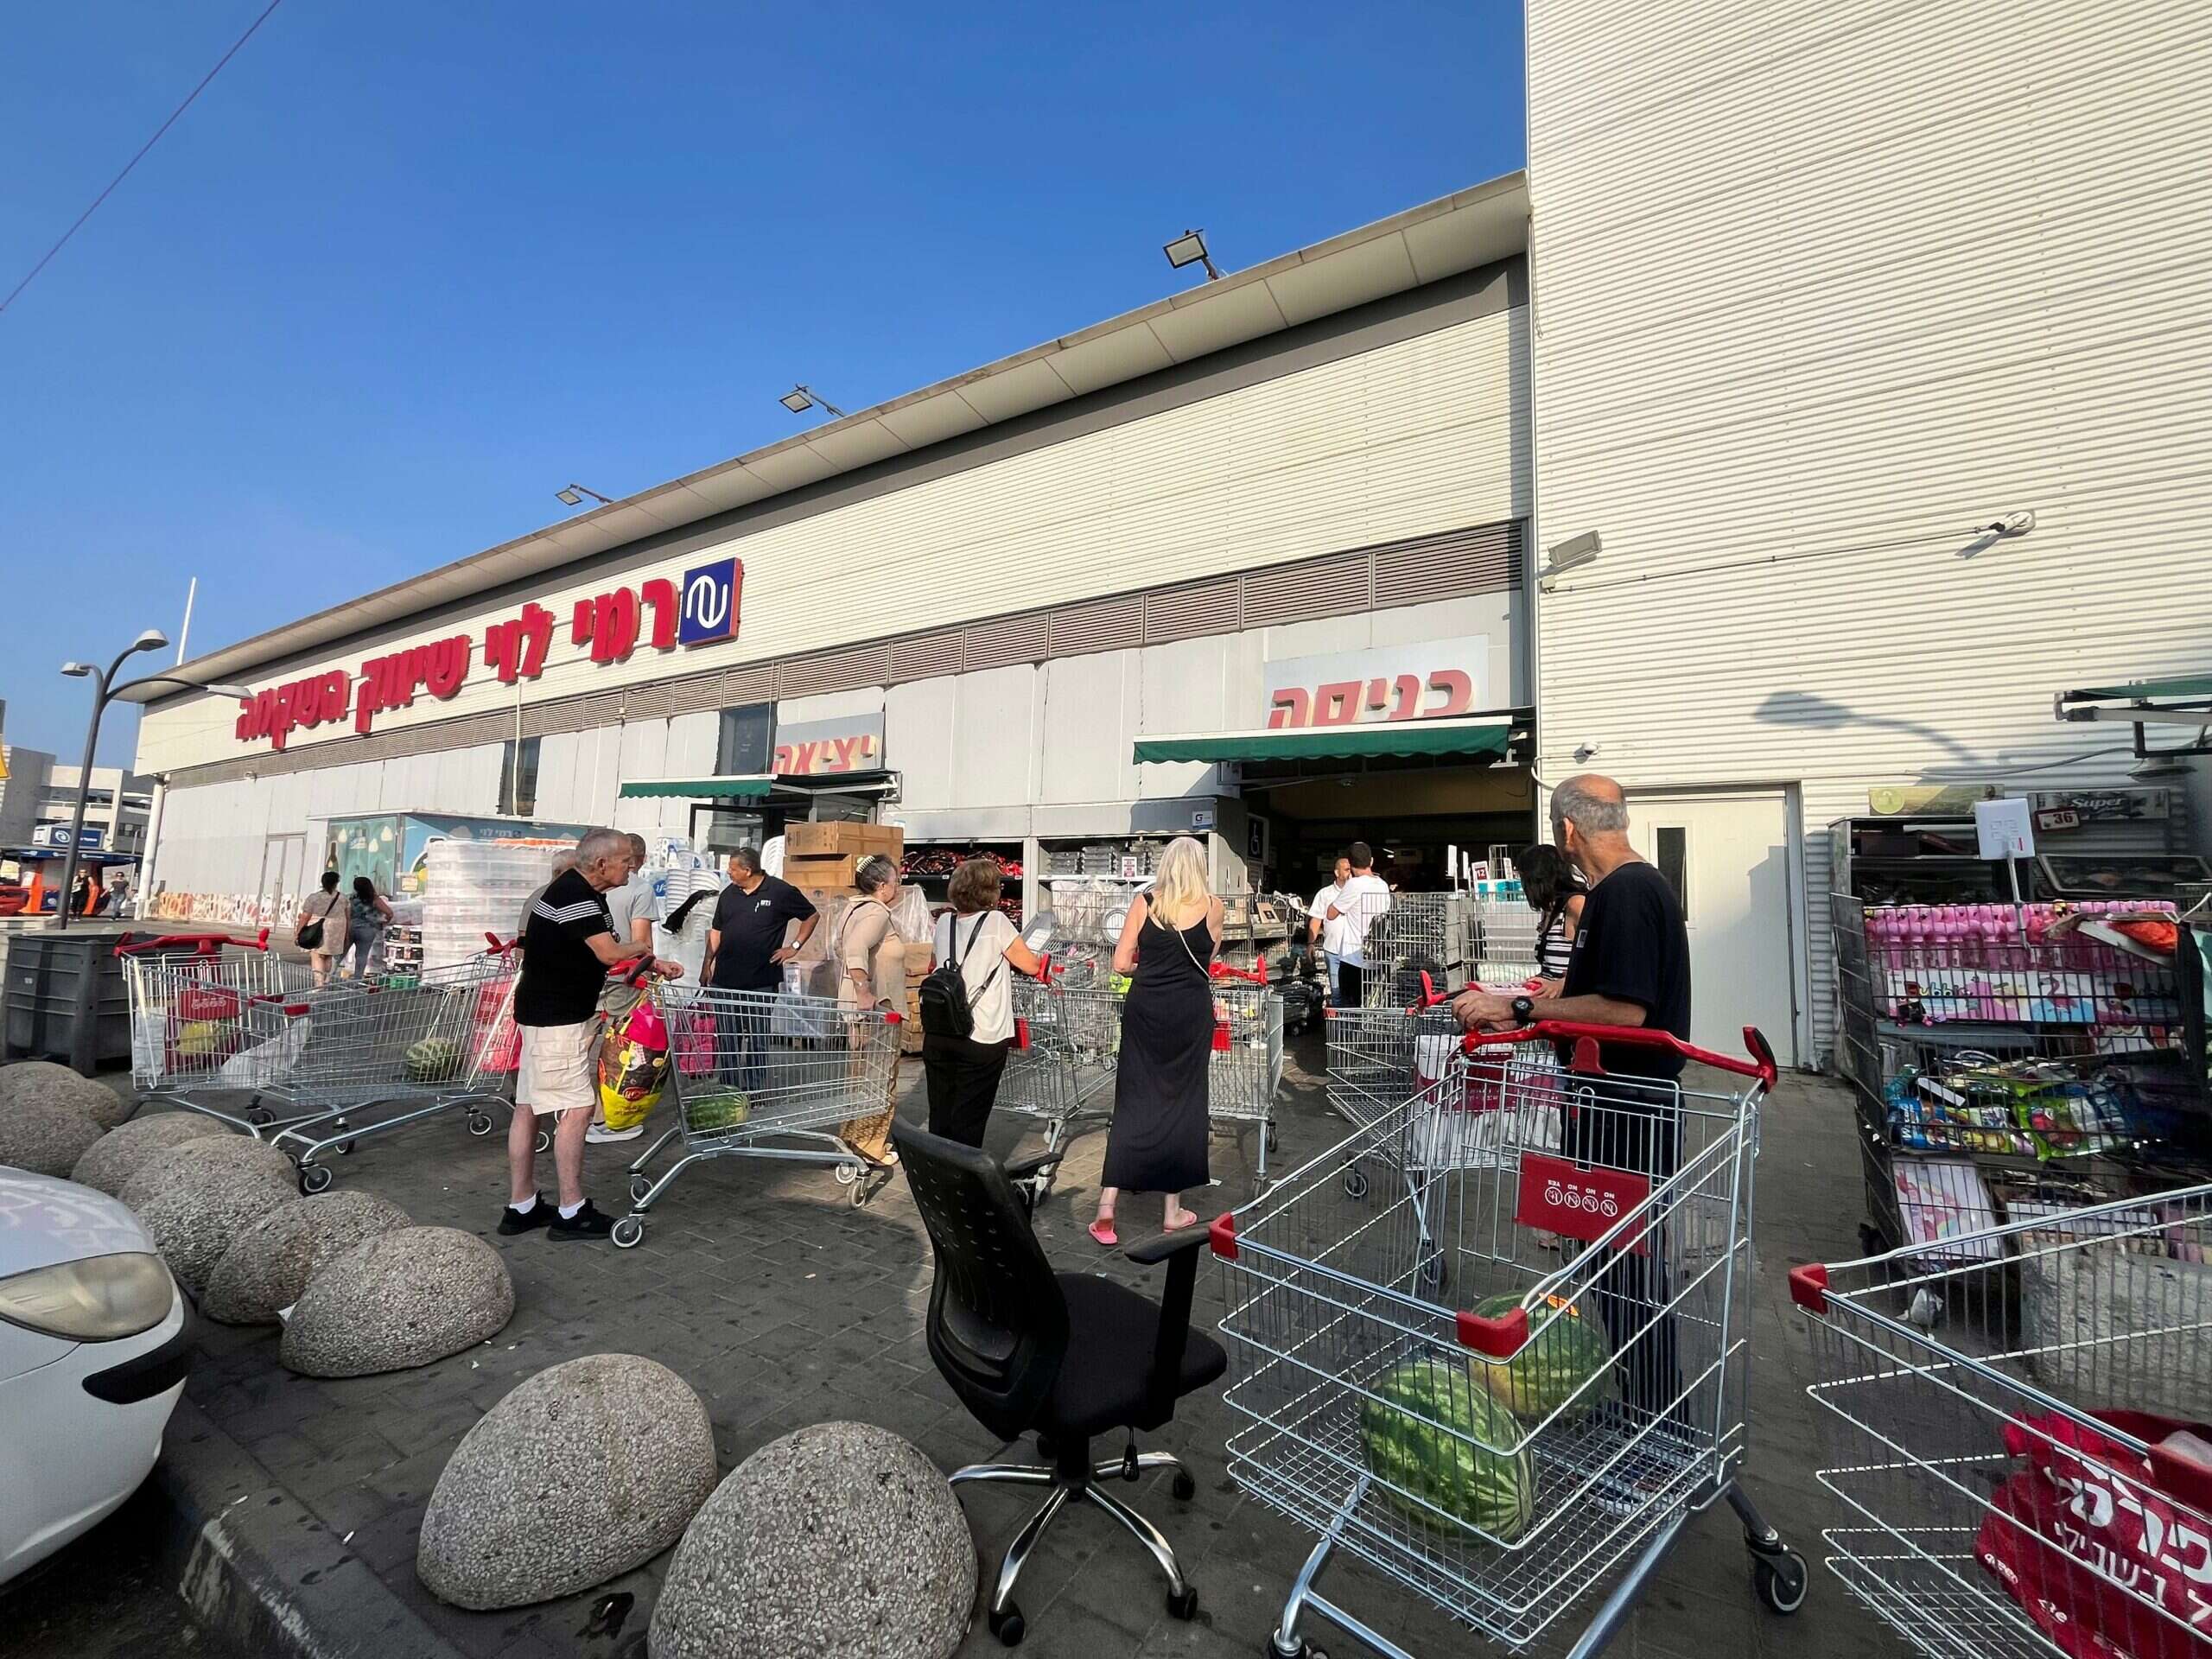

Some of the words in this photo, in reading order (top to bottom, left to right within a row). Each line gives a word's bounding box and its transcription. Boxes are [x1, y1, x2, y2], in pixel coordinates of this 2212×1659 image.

[485, 602, 554, 683] לוי
[572, 578, 681, 664] רמי
[236, 670, 350, 750] השקמה
[355, 634, 471, 734] שיווק
[1268, 669, 1472, 729] כניסה
[772, 734, 871, 774] יציאה
[2053, 812, 2074, 823] 36
[2070, 798, 2126, 810] Super
[1477, 868, 1486, 878] 12
